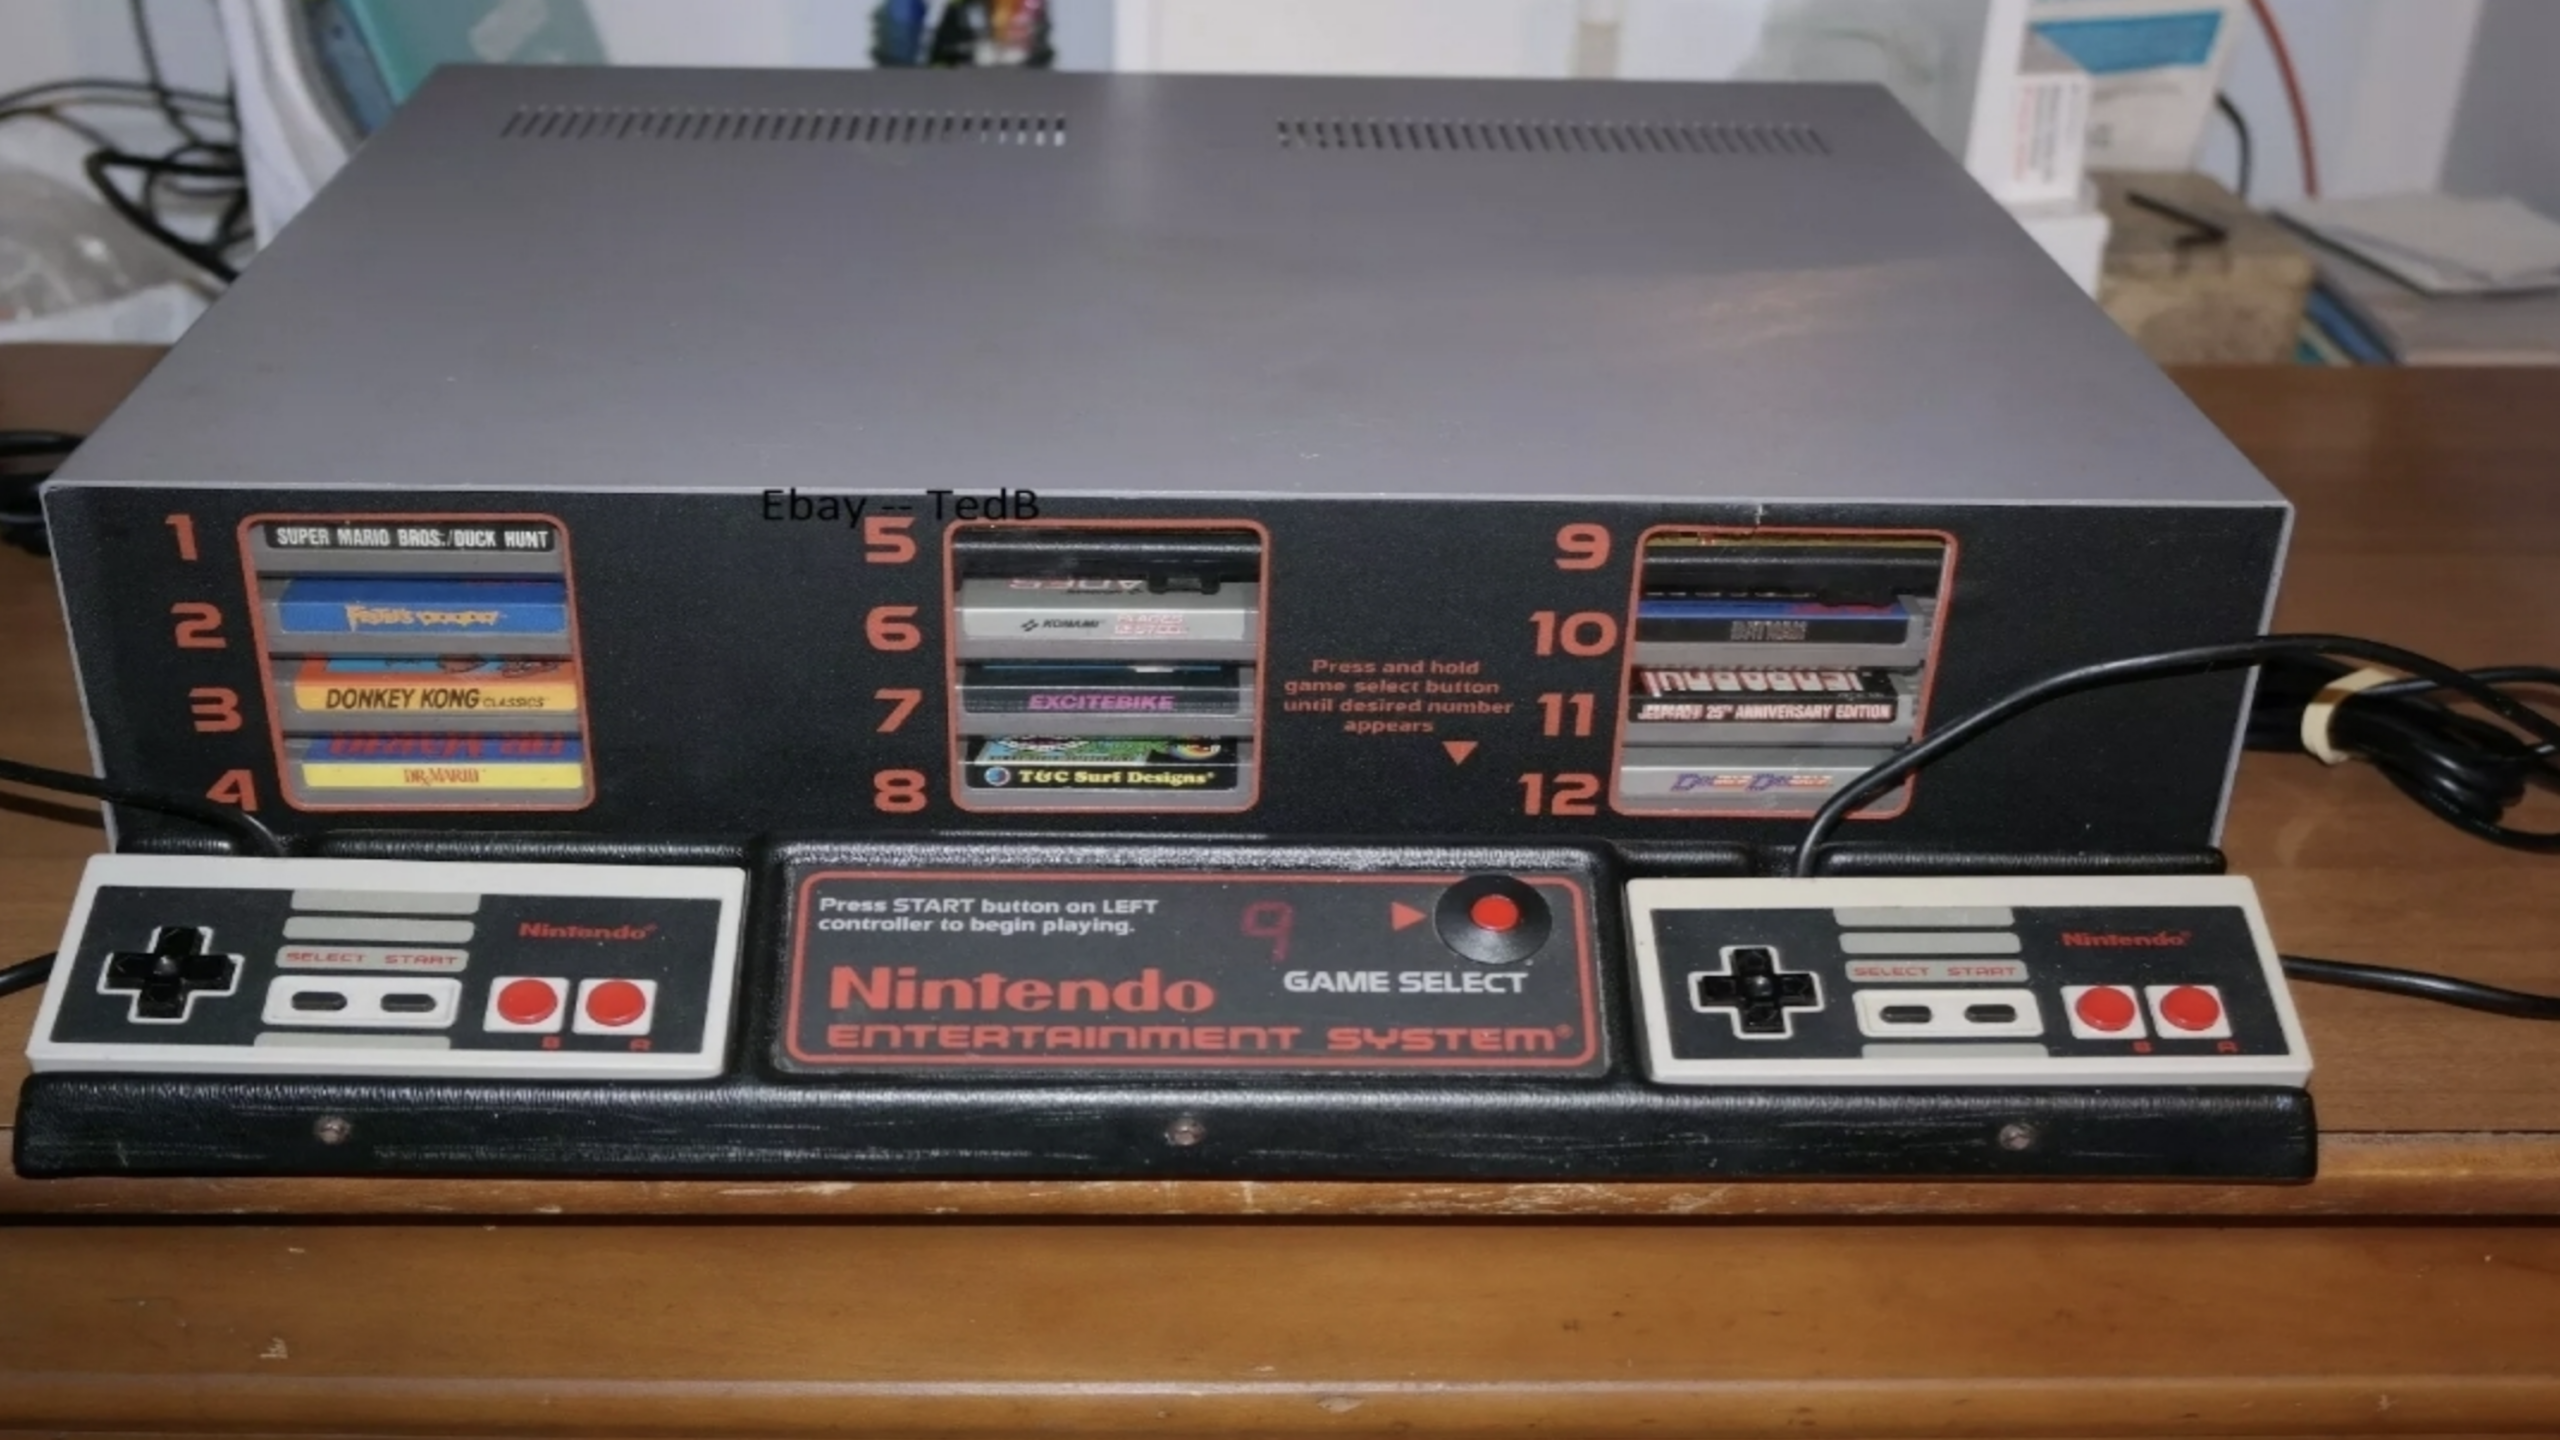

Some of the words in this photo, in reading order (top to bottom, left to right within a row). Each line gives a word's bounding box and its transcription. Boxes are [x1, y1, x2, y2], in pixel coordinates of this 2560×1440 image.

[165, 514, 197, 561] 1
[276, 527, 330, 546] SUPER
[337, 528, 390, 547] MARIO
[504, 530, 548, 549] HUNT
[864, 516, 916, 563] 5
[1555, 523, 1611, 570] 9
[171, 603, 228, 648] 2
[865, 606, 921, 651] 6
[1529, 611, 1617, 656] 10
[1312, 659, 1376, 674] Press
[1382, 660, 1424, 674] and
[1430, 661, 1480, 674] hold
[326, 688, 416, 709] DONKEY
[421, 688, 480, 709] KONG
[483, 697, 545, 708] CLASSICS
[1284, 681, 1346, 695] game
[1354, 680, 1420, 694] select
[1425, 680, 1500, 694] button
[188, 688, 242, 732] 3
[874, 689, 923, 732] 7
[1028, 694, 1175, 710] EXCITEBIKE
[1284, 699, 1332, 712] until
[1339, 699, 1422, 712] desired
[1427, 700, 1514, 714] number
[1735, 704, 1831, 720] ANNIVERSARY
[1835, 704, 1891, 720] EDITION
[1537, 693, 1593, 736] 11
[1343, 720, 1434, 734] appears
[1018, 769, 1069, 783] T&C
[1074, 769, 1121, 784] Surf
[206, 769, 258, 812] 4
[874, 769, 926, 813] 8
[1518, 773, 1599, 815] 12
[819, 897, 887, 913] Press
[893, 898, 975, 913] START
[981, 898, 1058, 914] button
[1065, 901, 1096, 914] on
[1102, 899, 1159, 914] LEFT
[818, 916, 933, 932] controller
[940, 917, 964, 932] to
[970, 916, 1036, 935] begin
[1042, 916, 1135, 936] playing.
[1241, 900, 1295, 963] 9
[286, 952, 367, 964] SELECT
[384, 953, 459, 966] START
[1283, 970, 1390, 993] GAME
[1398, 971, 1529, 994] SELECT
[1854, 966, 1931, 977] SELECT
[1947, 966, 2018, 977] START
[829, 965, 1214, 1012] Nintendo
[542, 1036, 560, 1050] B
[630, 1037, 652, 1051] A
[827, 1023, 1303, 1050] ENTERTAINMENT
[2133, 1040, 2152, 1053] B
[2216, 1040, 2239, 1053] A
